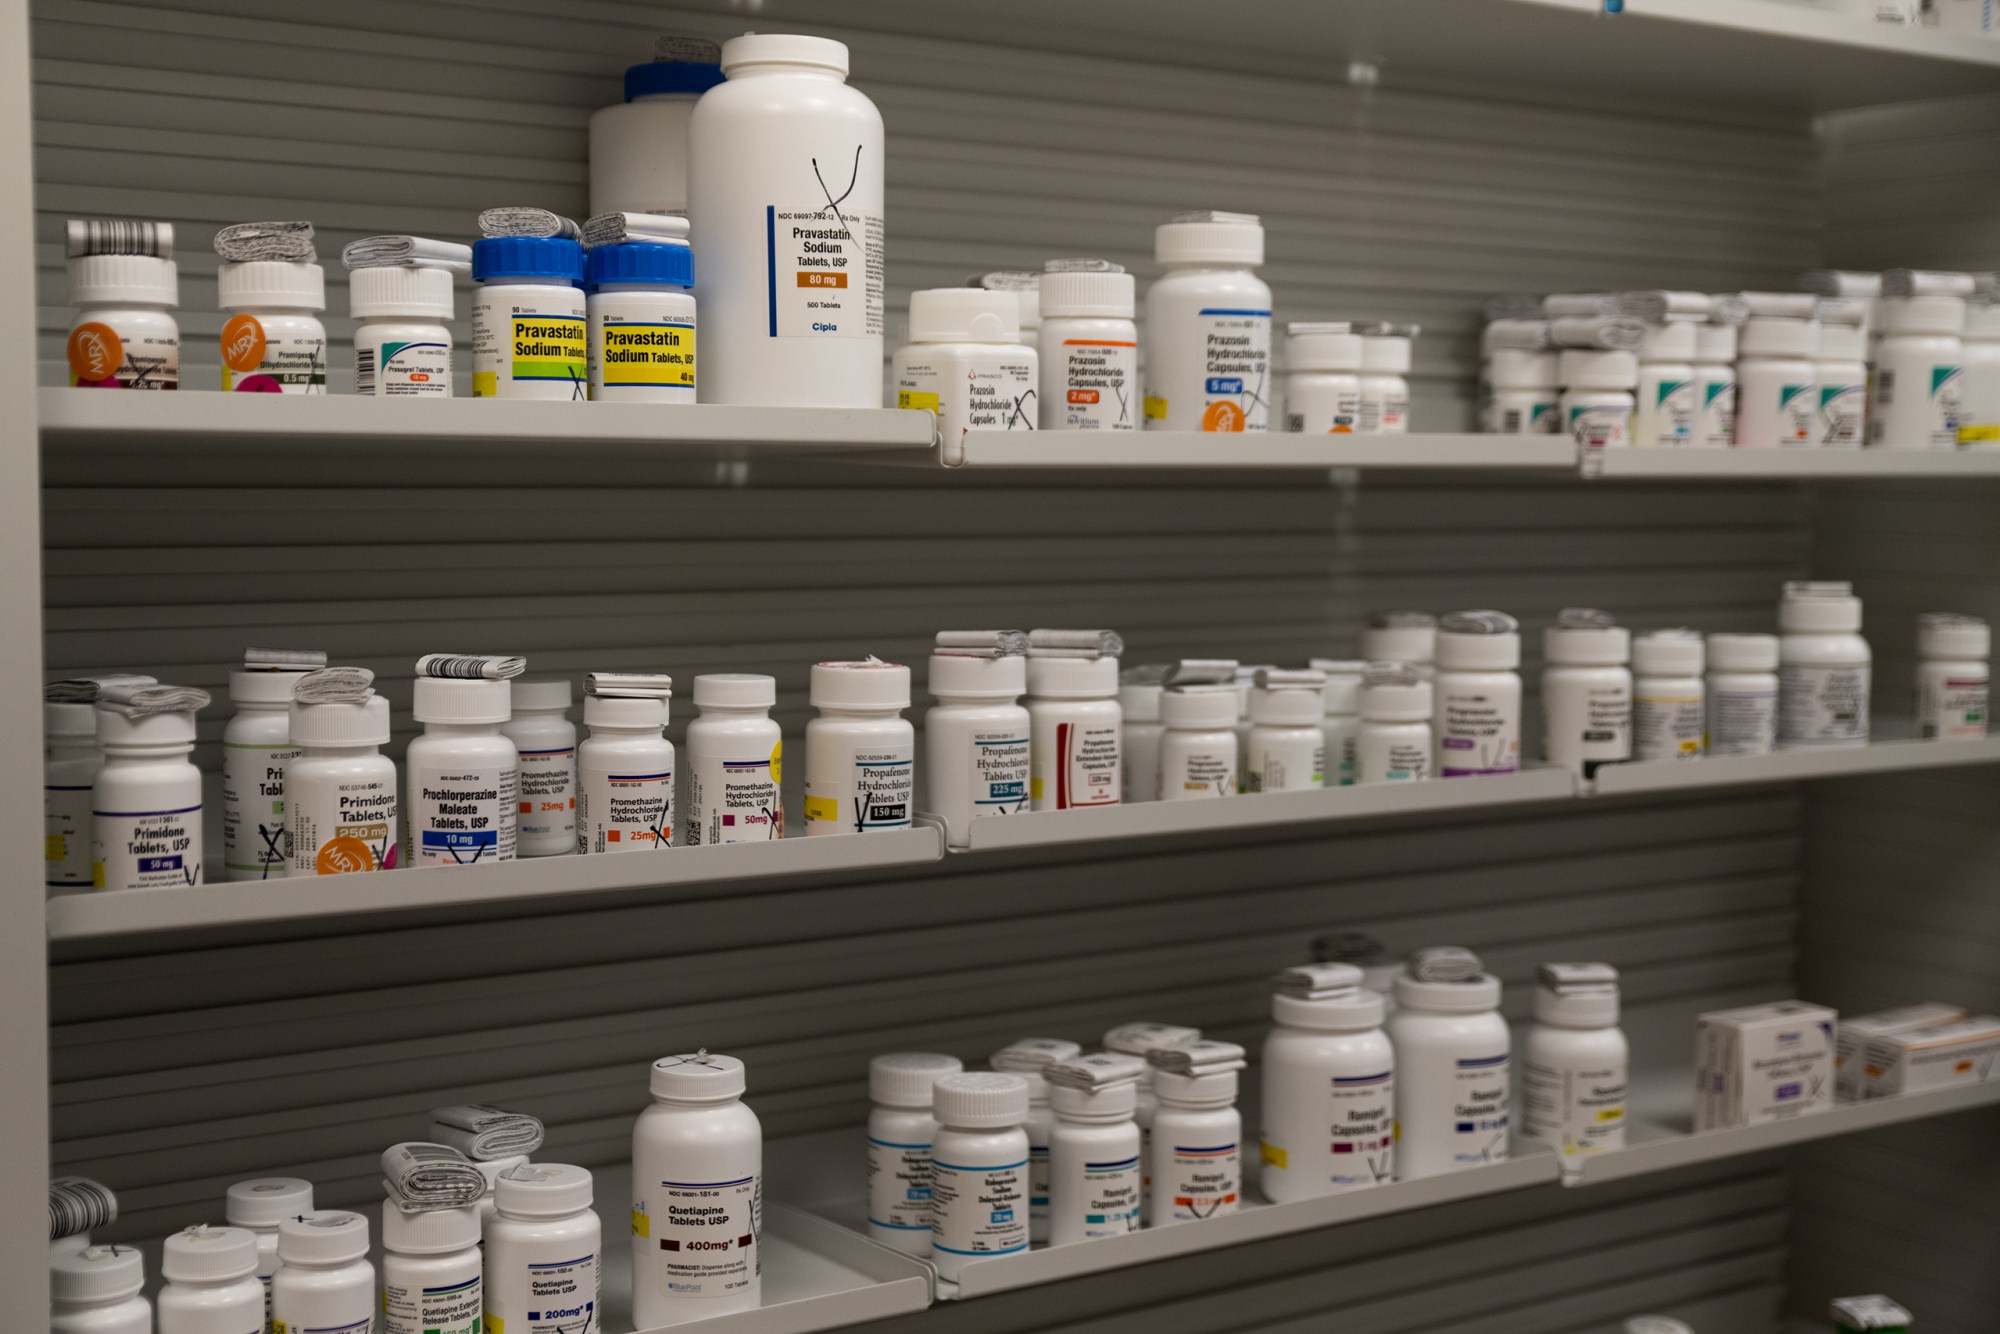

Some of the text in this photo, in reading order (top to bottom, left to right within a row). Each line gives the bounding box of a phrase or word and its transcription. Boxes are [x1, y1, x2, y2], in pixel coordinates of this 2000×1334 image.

[841, 214, 860, 223] Rx Only
[793, 227, 850, 240] Pravastatin
[804, 242, 842, 254] Sodium
[797, 257, 848, 268] Tablets, USP
[810, 275, 837, 287] 80 mg
[516, 323, 584, 340] Pravastatin
[812, 323, 837, 332] Cipla
[605, 331, 680, 346] Pravastatin
[1207, 333, 1250, 346] Prazosin
[515, 342, 562, 356] Sodium
[605, 349, 649, 363] Sodium
[651, 352, 684, 365] Tablets,
[1068, 355, 1106, 366] Prazosin
[1068, 366, 1124, 378] Hydrochloride
[1206, 361, 1253, 374] Capsules,
[283, 374, 297, 383] 0.5
[680, 372, 688, 381] 40
[1068, 378, 1109, 389] Capsules,
[969, 384, 996, 396] Prazosin
[1071, 391, 1077, 401] 2
[969, 398, 1013, 412] Hydrochloride
[969, 412, 1006, 426] Capsules 1
[981, 745, 1027, 758] Propafenone
[521, 769, 569, 779] Promethazine
[862, 766, 910, 780] Propafenone
[982, 771, 1013, 781] Tablets
[339, 784, 350, 792] NDC
[521, 777, 570, 788] Hydrochloride
[725, 782, 773, 791] Promethazine
[857, 777, 911, 793] Hydrochloride
[551, 786, 565, 794] USP
[992, 784, 1024, 795] 225 mg
[340, 794, 395, 808] Primidone
[422, 788, 497, 803] Prochlorperazine
[610, 796, 663, 806] Promethazine
[725, 790, 774, 801] Hydrochloride
[896, 791, 910, 802] USP
[541, 802, 564, 812] 25mg
[725, 798, 769, 808] Tablets, USP
[439, 804, 477, 815] Maleate
[610, 804, 664, 816] Hydrochloride
[873, 807, 904, 818] 150 mg
[339, 810, 386, 823] Tablets,
[610, 814, 658, 824] Tablets, USP
[744, 815, 768, 825] 50mg
[430, 816, 489, 831] Tablets, USP
[134, 825, 185, 840] Primidone
[339, 827, 387, 838] 250 mg
[630, 830, 657, 842] 25mg
[446, 834, 473, 845] 10 mg
[127, 838, 190, 855] Tablets, USP
[150, 860, 174, 870] 50 mg
[668, 1205, 724, 1217] Quetiapine
[668, 1215, 729, 1226] Tablets USP
[667, 1263, 701, 1271] PHARMACIST:
[693, 1270, 707, 1278] guide
[532, 1278, 573, 1289] Quetiapine
[532, 1285, 577, 1296] Tablets USP
[422, 1305, 458, 1318] Quetiapine
[422, 1316, 449, 1326] Release
[471, 1304, 480, 1316] USP
